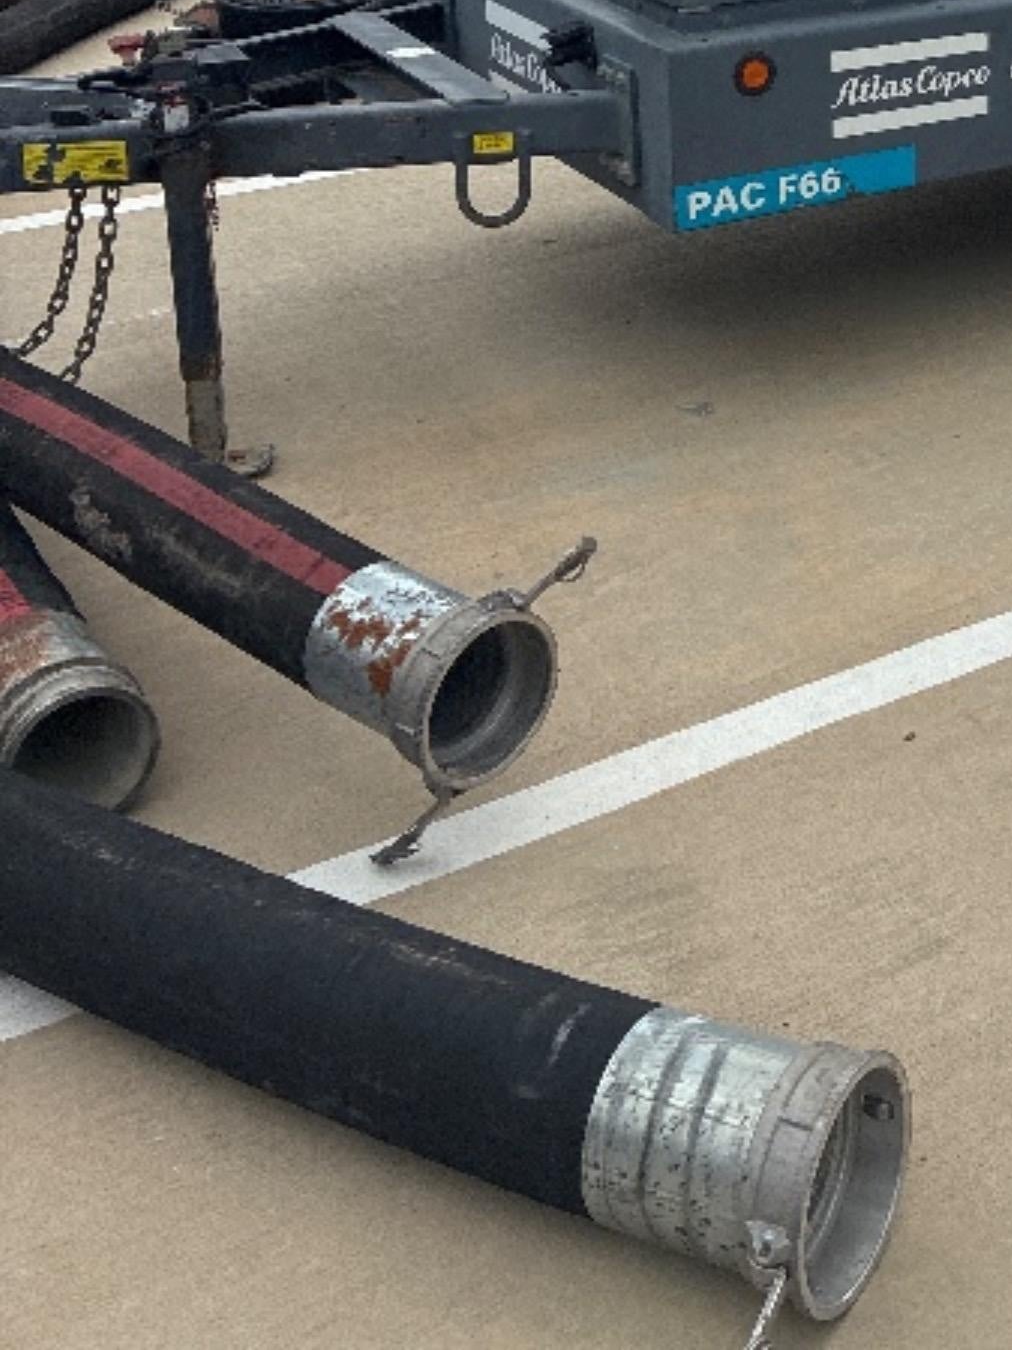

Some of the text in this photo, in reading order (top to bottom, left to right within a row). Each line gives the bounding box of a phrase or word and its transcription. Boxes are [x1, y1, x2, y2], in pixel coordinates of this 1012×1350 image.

[830, 64, 991, 109] Atlas Copco
[686, 166, 841, 220] PAC F66
